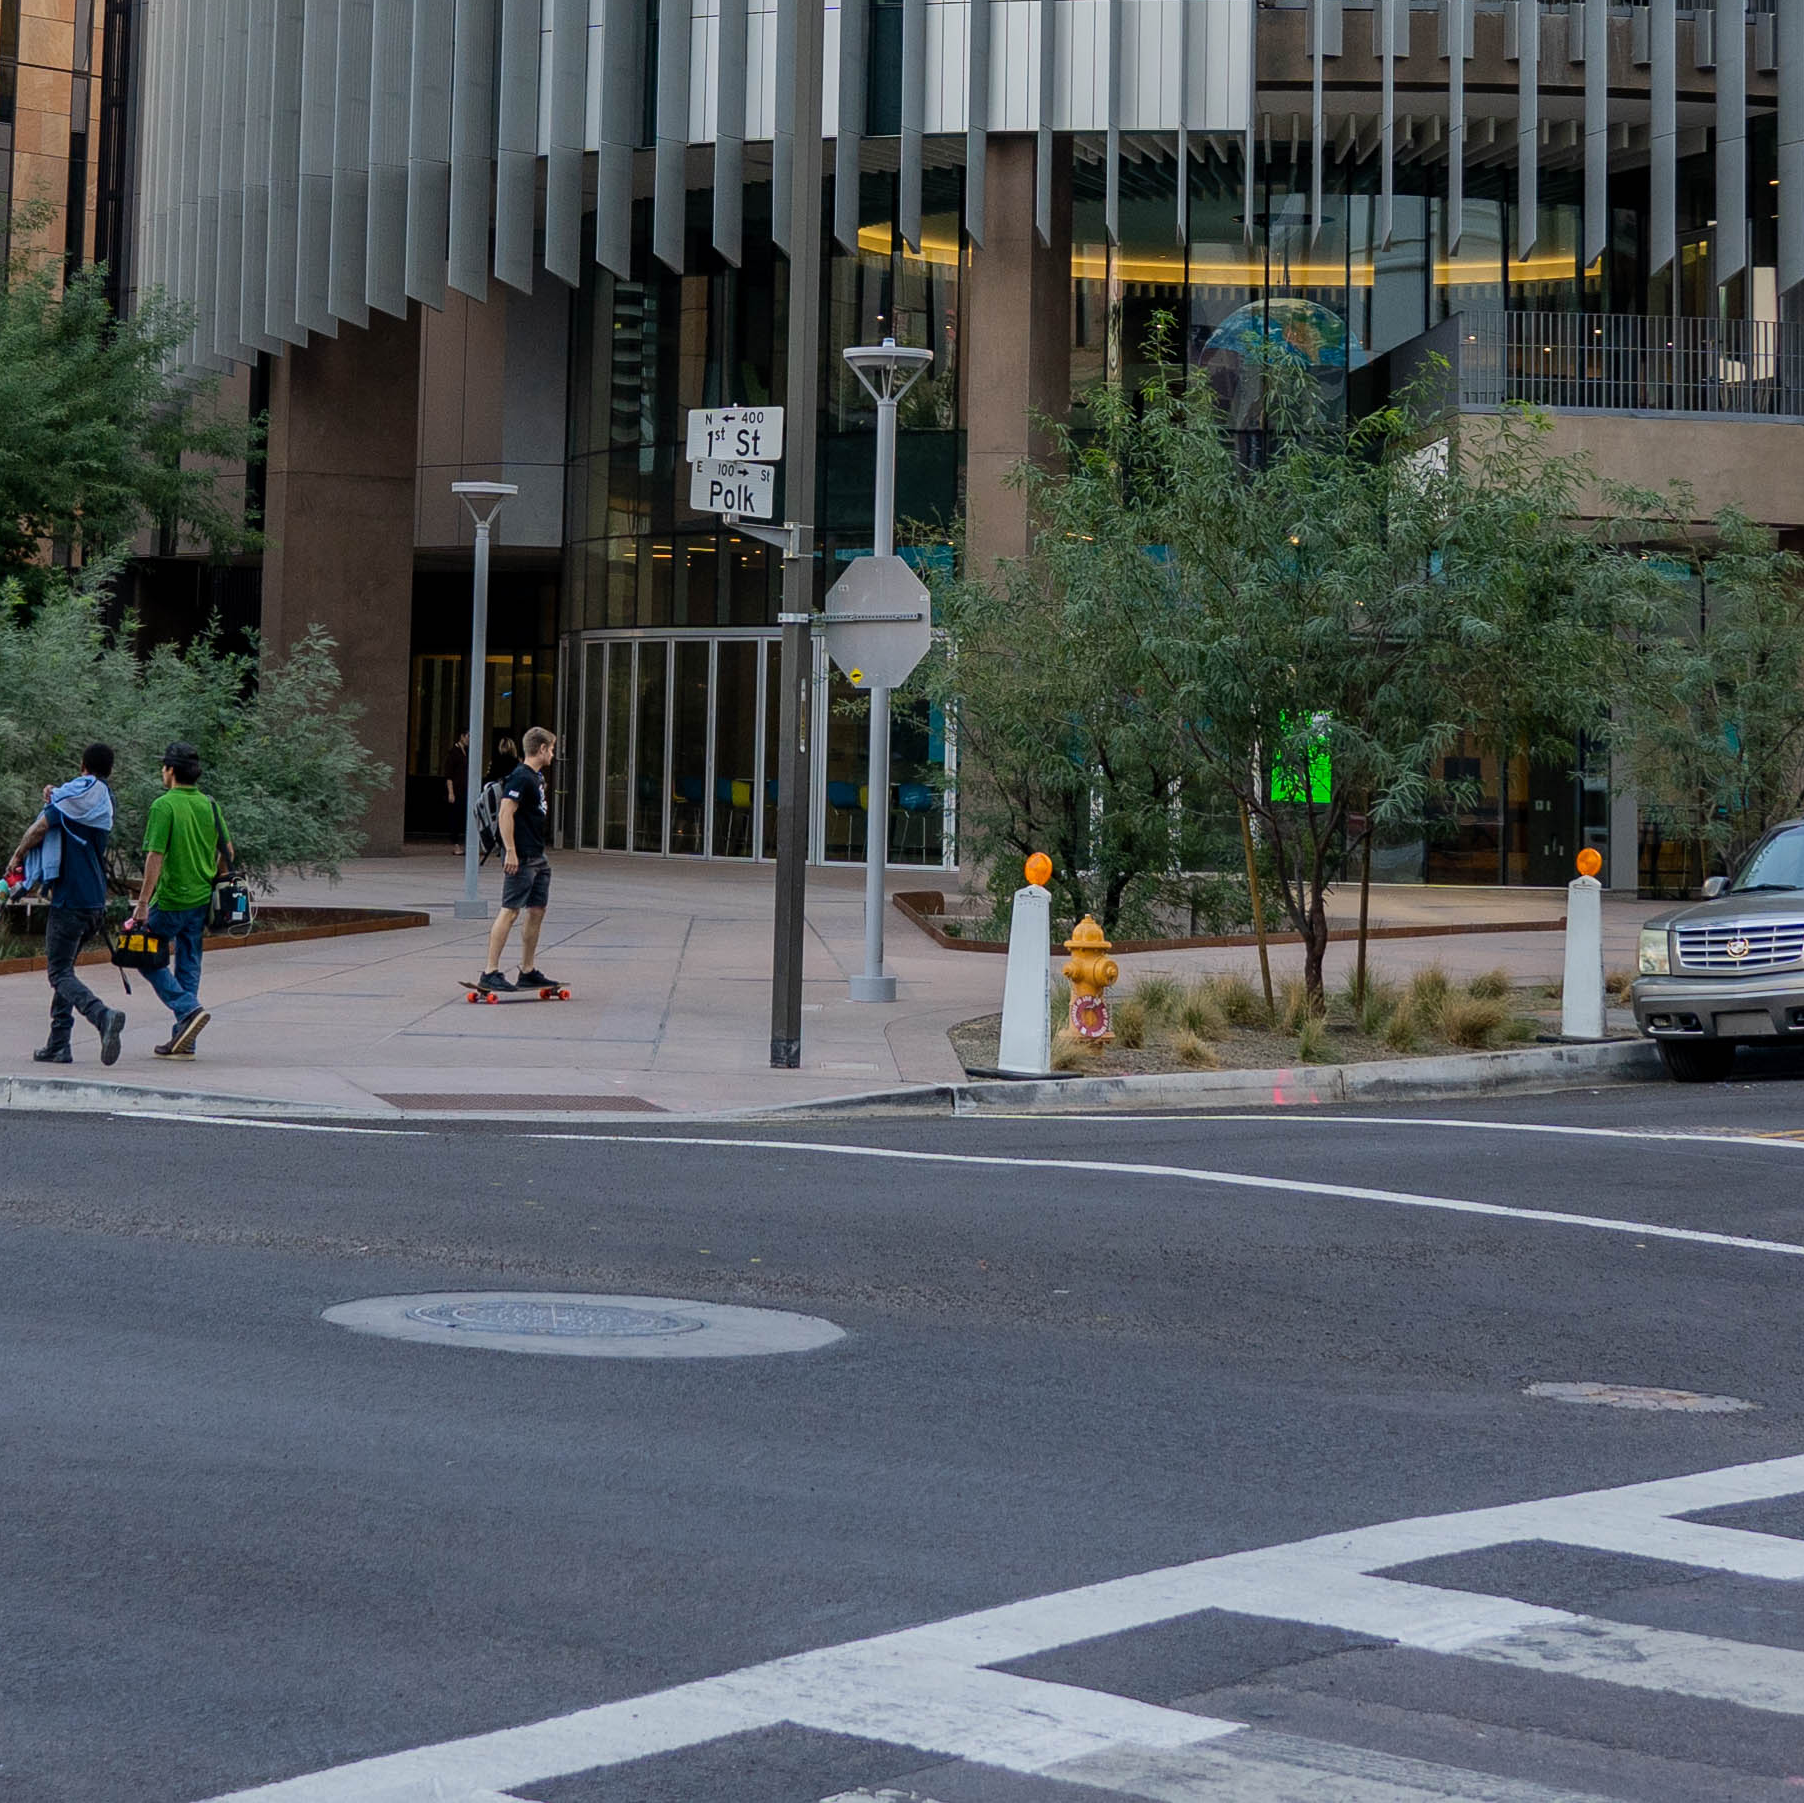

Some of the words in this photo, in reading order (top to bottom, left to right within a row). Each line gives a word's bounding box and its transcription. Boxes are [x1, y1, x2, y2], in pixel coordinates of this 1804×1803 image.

[705, 413, 713, 425] N
[741, 412, 764, 424] 400
[707, 427, 726, 457] 1st
[736, 429, 761, 456] St
[697, 461, 703, 473] E
[718, 463, 735, 477] 100
[760, 470, 770, 482] St
[709, 480, 755, 513] Polk
